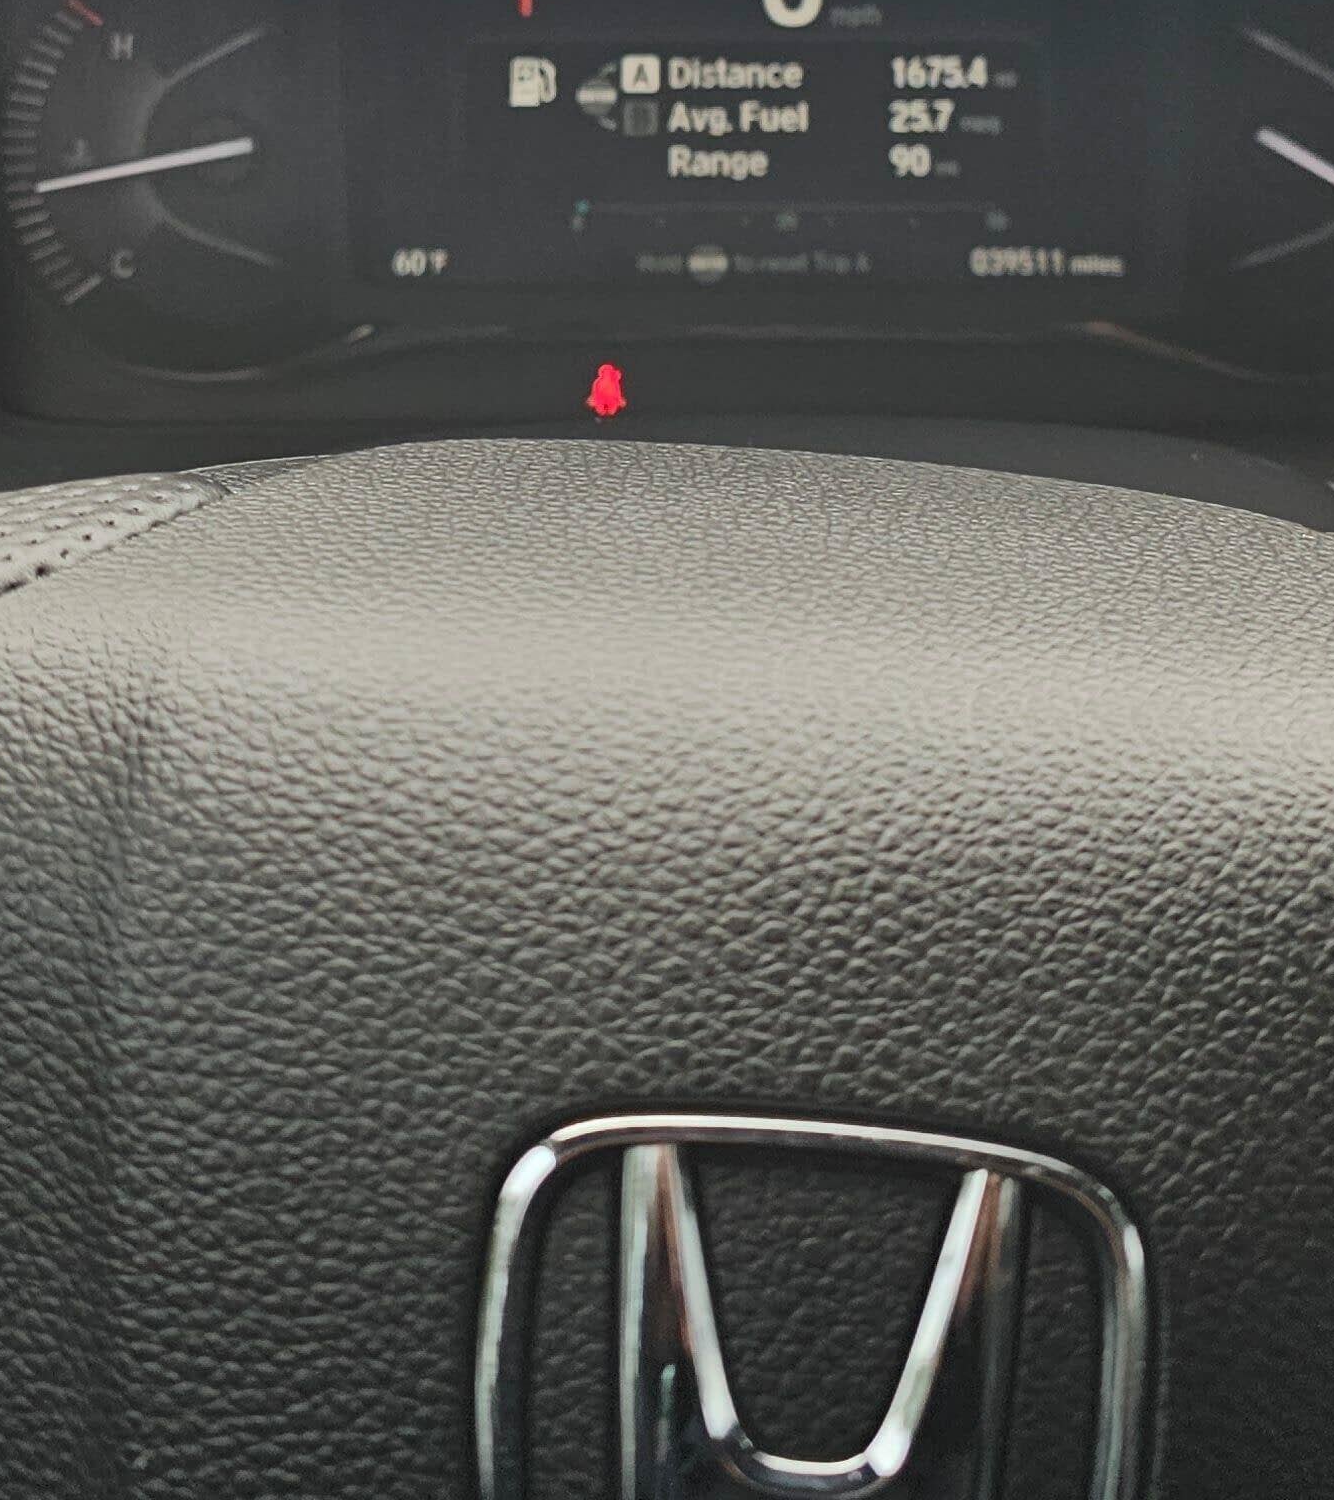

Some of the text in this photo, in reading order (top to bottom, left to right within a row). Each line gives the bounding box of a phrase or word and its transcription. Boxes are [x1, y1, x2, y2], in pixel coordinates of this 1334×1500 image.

[110, 33, 134, 60] H
[668, 57, 804, 90] Distance
[892, 55, 988, 89] 1675.4
[669, 101, 733, 136] Avg.
[739, 100, 809, 133] Fuel
[668, 144, 769, 181] Range
[888, 143, 932, 178] 90
[111, 251, 135, 279] C
